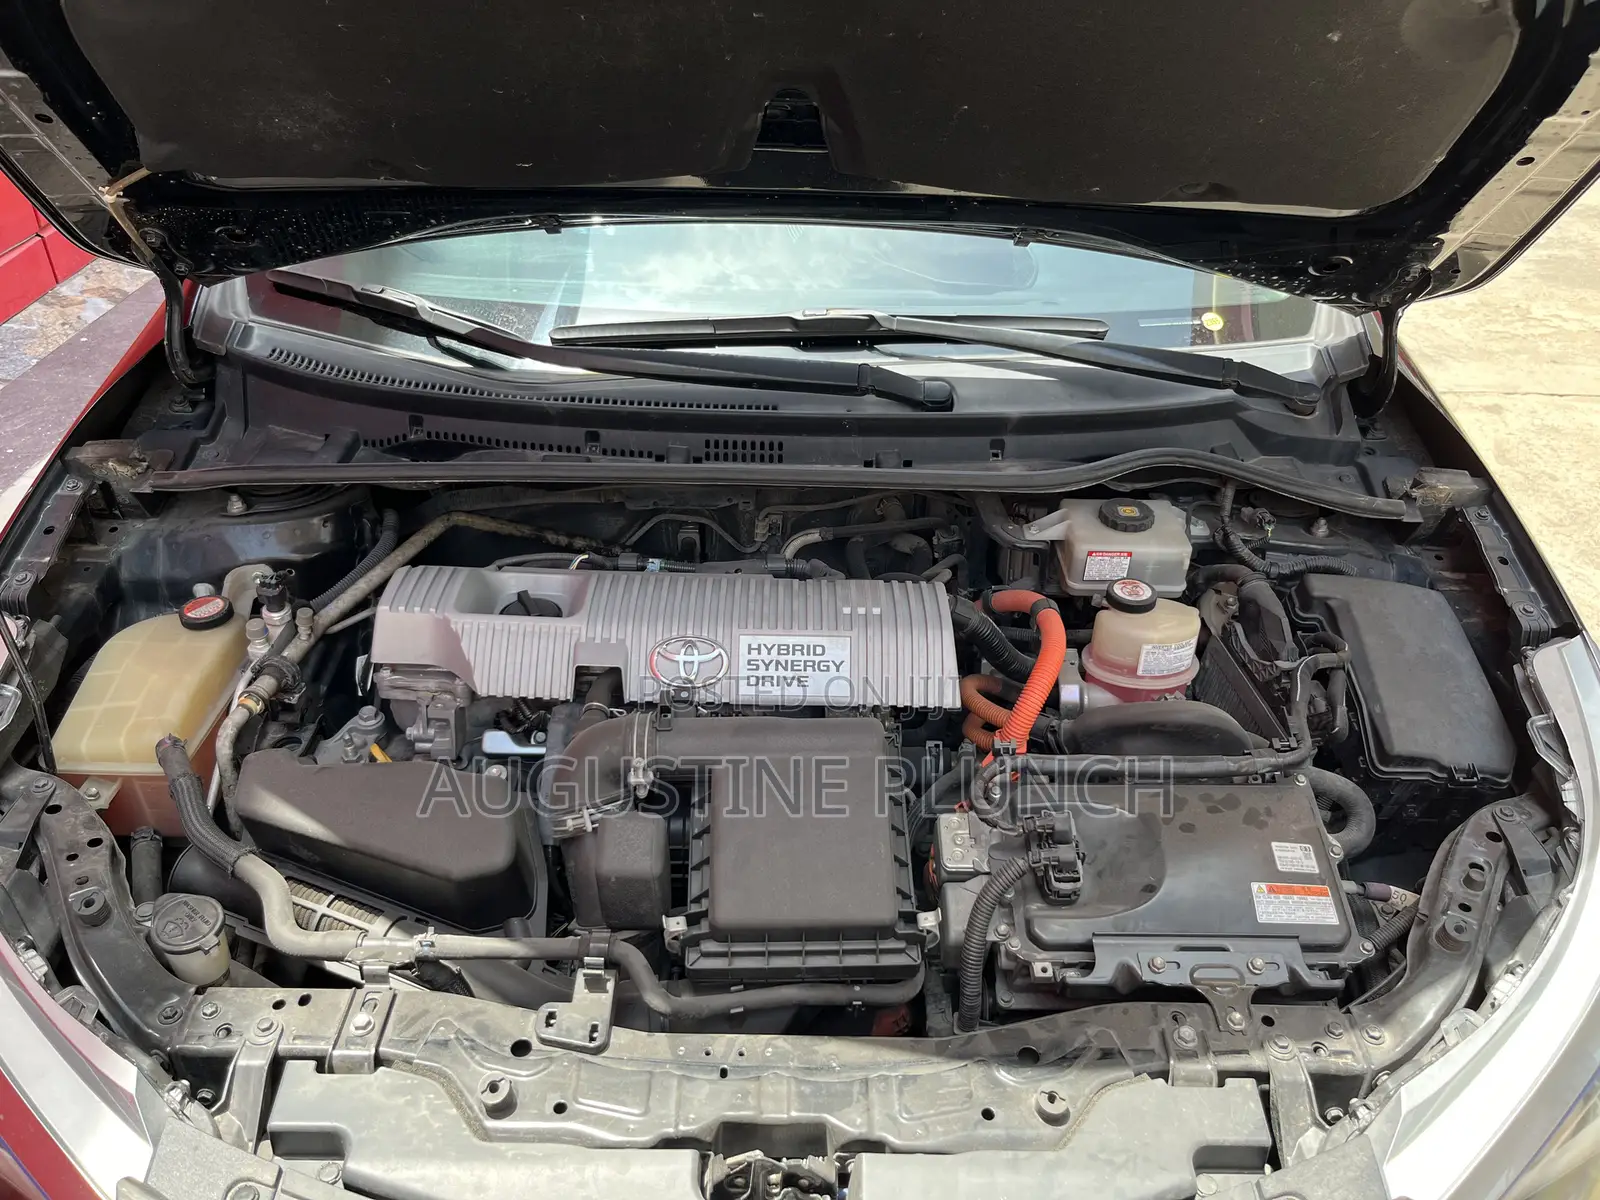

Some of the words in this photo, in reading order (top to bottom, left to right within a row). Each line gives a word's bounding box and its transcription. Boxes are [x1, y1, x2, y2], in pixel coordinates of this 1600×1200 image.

[747, 643, 826, 657] HYBRID
[746, 659, 845, 673] SYNERGY
[746, 675, 809, 688] DRIVE
